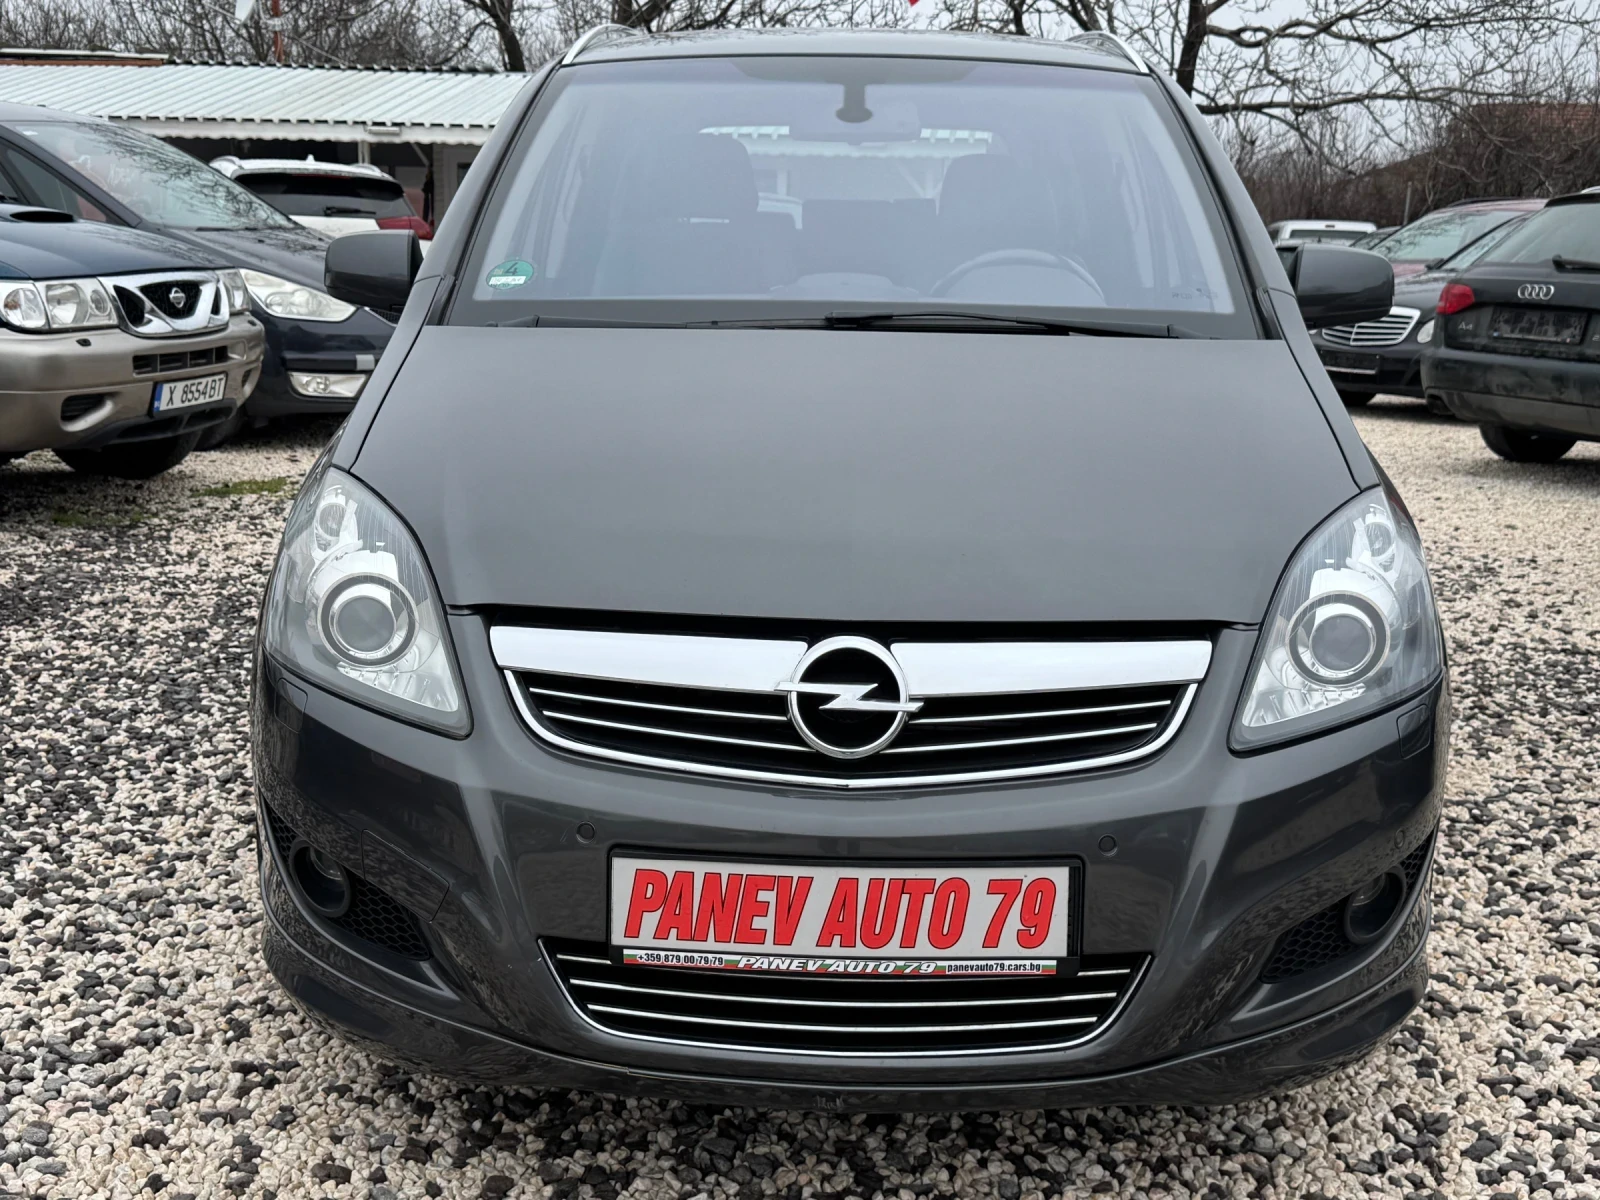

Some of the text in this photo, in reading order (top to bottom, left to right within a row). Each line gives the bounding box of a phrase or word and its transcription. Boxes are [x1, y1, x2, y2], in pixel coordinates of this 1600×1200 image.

[504, 261, 518, 276] 4
[1458, 321, 1473, 330] A4
[623, 868, 1057, 949] PANEV AUTO 79
[637, 952, 724, 966] +359 879 00 79 79
[737, 955, 938, 974] PANEV AUTO 79
[947, 962, 1041, 973] panevauto79.cars.bg
